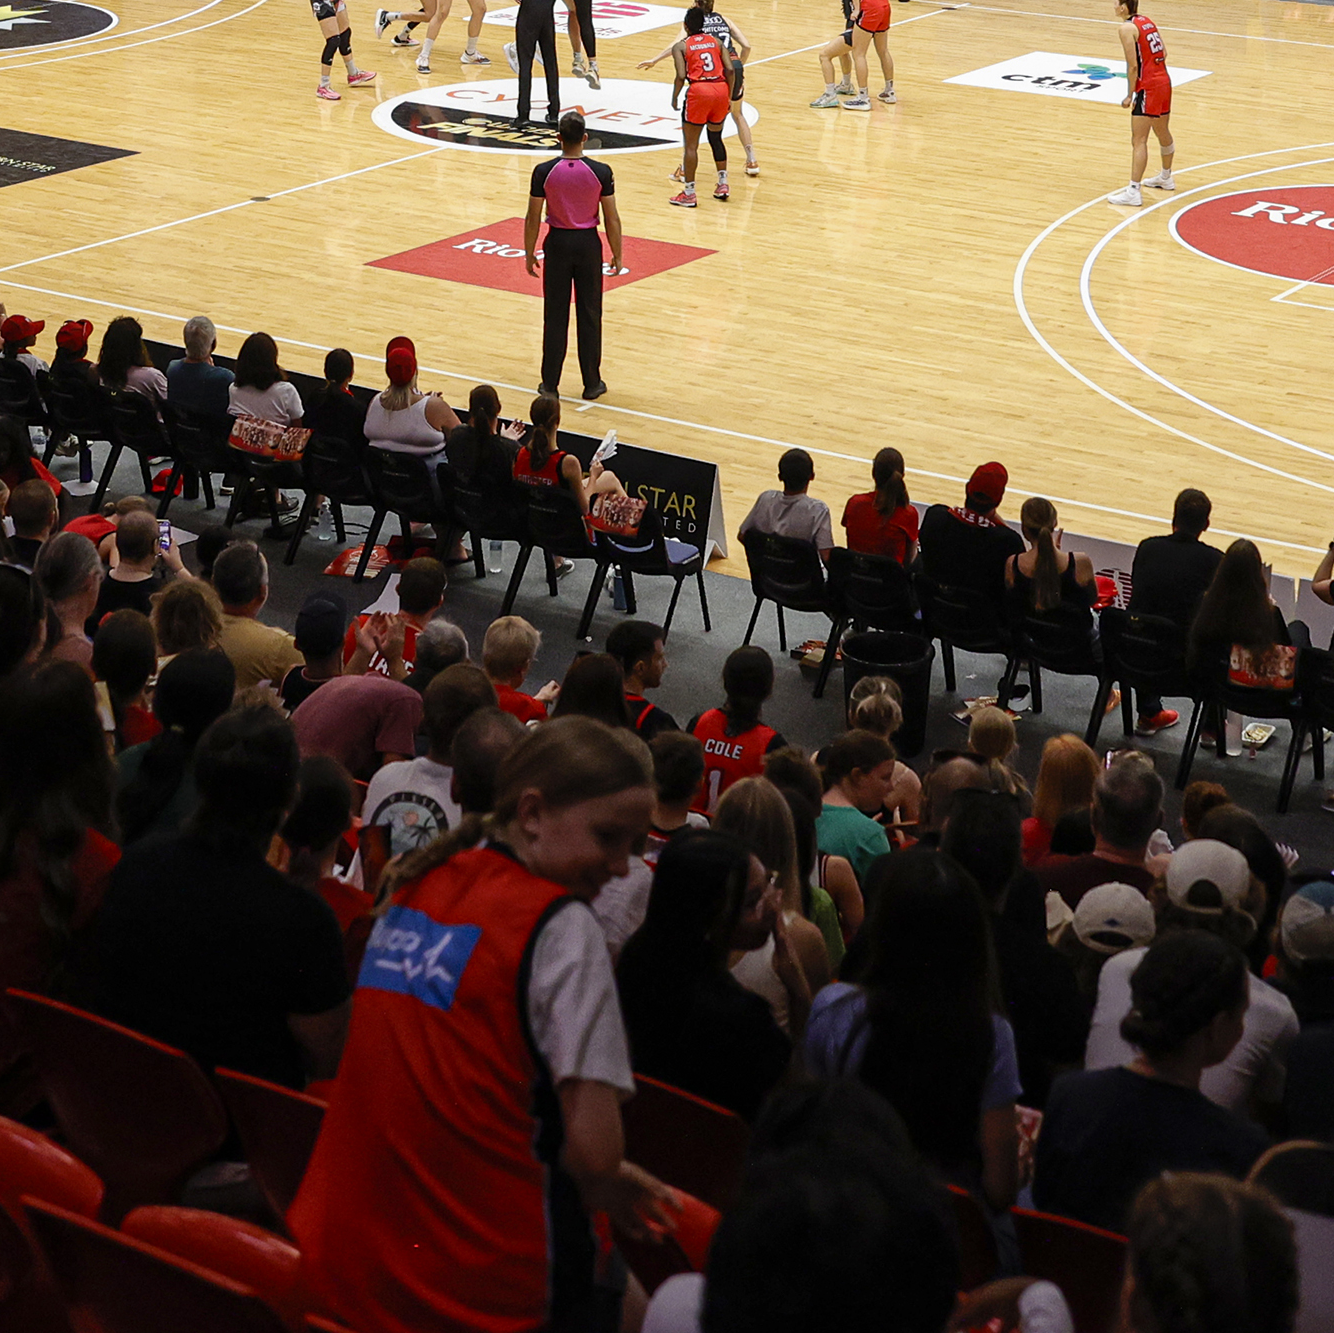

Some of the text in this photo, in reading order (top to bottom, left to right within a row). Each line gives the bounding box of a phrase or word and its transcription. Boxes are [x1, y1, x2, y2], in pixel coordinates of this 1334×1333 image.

[1146, 31, 1164, 55] 25
[698, 52, 716, 72] 3
[1000, 74, 1101, 91] ctm
[417, 120, 561, 149] FINALS
[452, 238, 527, 258] Rio
[638, 484, 698, 520] STAR
[703, 738, 744, 762] COLE
